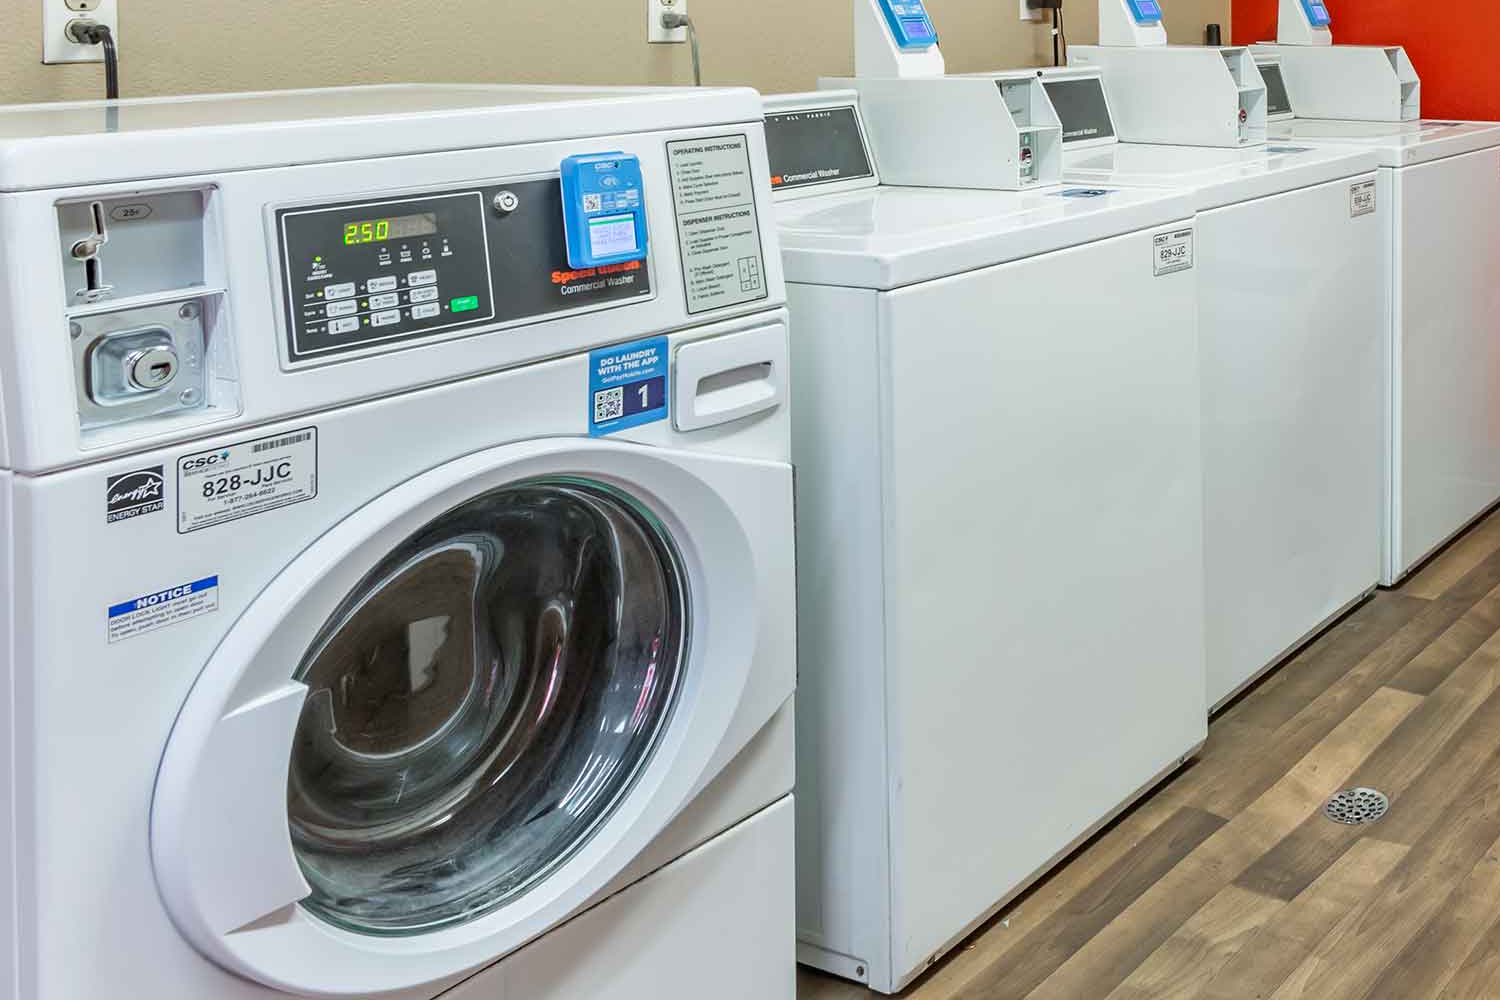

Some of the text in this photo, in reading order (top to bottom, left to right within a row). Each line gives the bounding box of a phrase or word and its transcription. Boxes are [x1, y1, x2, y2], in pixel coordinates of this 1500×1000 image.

[673, 143, 742, 156] OPERATING INSTRUCTIONS
[683, 210, 751, 226] DISPENSER INSTRUCTIONS
[344, 220, 389, 245] 2.50
[561, 274, 634, 295] Commercial Washer
[598, 356, 659, 375] WITH THE APP
[600, 348, 657, 367] DO LAUNDRY
[638, 384, 649, 408] 1
[183, 454, 219, 470] CSC
[202, 462, 292, 498] 828-JJC
[108, 503, 164, 522] ENERGY STAR
[136, 584, 193, 609] NOTICE
[110, 615, 131, 626] DOOR
[132, 610, 150, 620] LOCK
